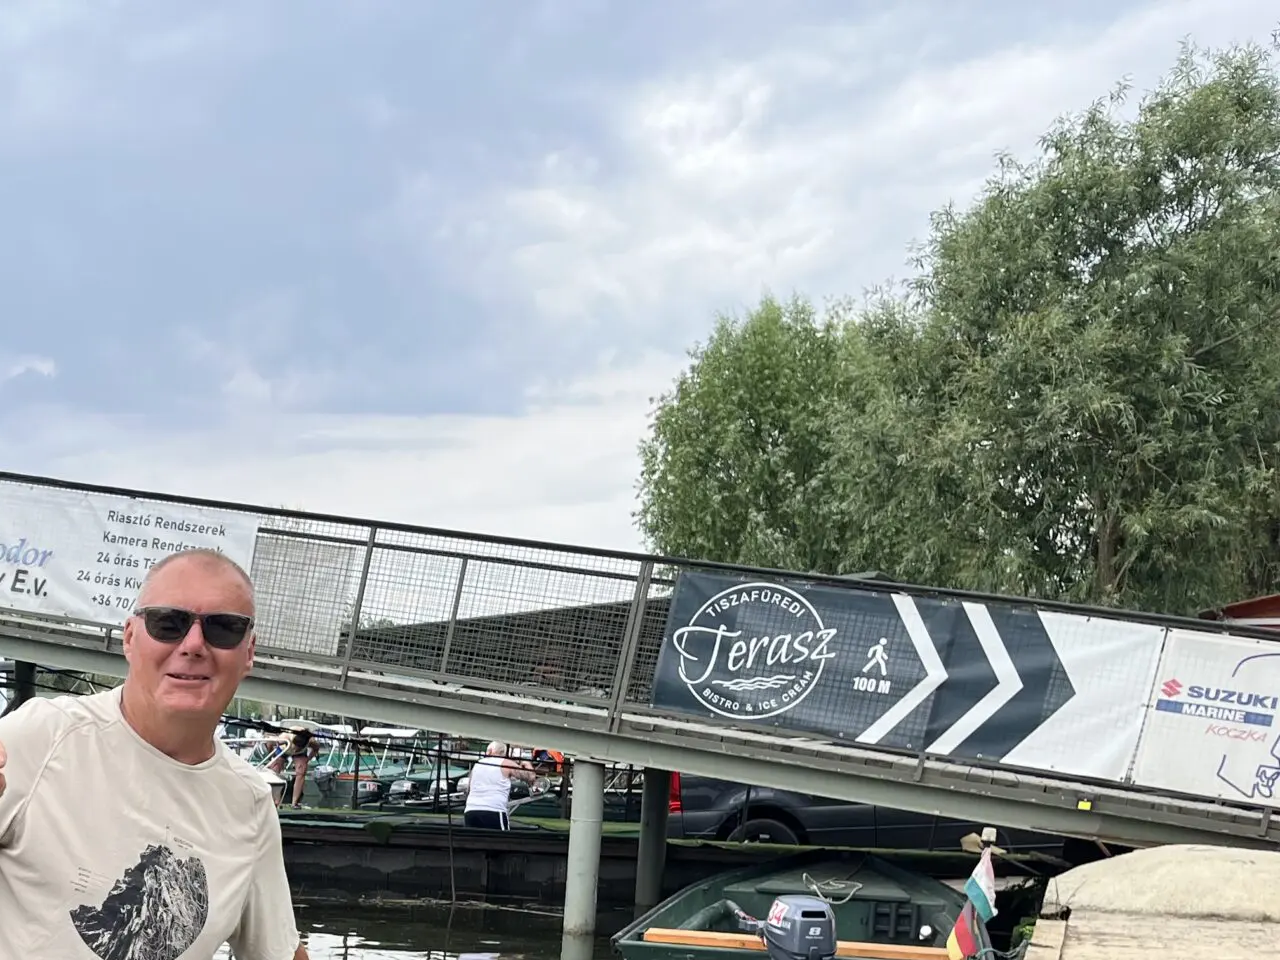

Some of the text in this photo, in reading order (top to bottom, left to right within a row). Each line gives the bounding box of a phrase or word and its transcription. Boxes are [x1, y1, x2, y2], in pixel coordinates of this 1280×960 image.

[107, 510, 226, 537] Riasztó Rendszerek
[103, 531, 148, 548] Kamera
[96, 551, 110, 563] 24
[114, 553, 140, 568] órás
[76, 570, 91, 582] 24
[94, 572, 121, 587] órás
[91, 594, 111, 606] +36
[705, 589, 807, 618] TISZAFÜREDI
[673, 624, 838, 685] Terasz
[702, 670, 814, 712] BISTRO & ICE CREAM
[852, 676, 891, 695] 100 M
[1187, 685, 1279, 709] SUZUKI
[1181, 703, 1246, 723] MARINE
[1205, 723, 1268, 743] KOCZKA
